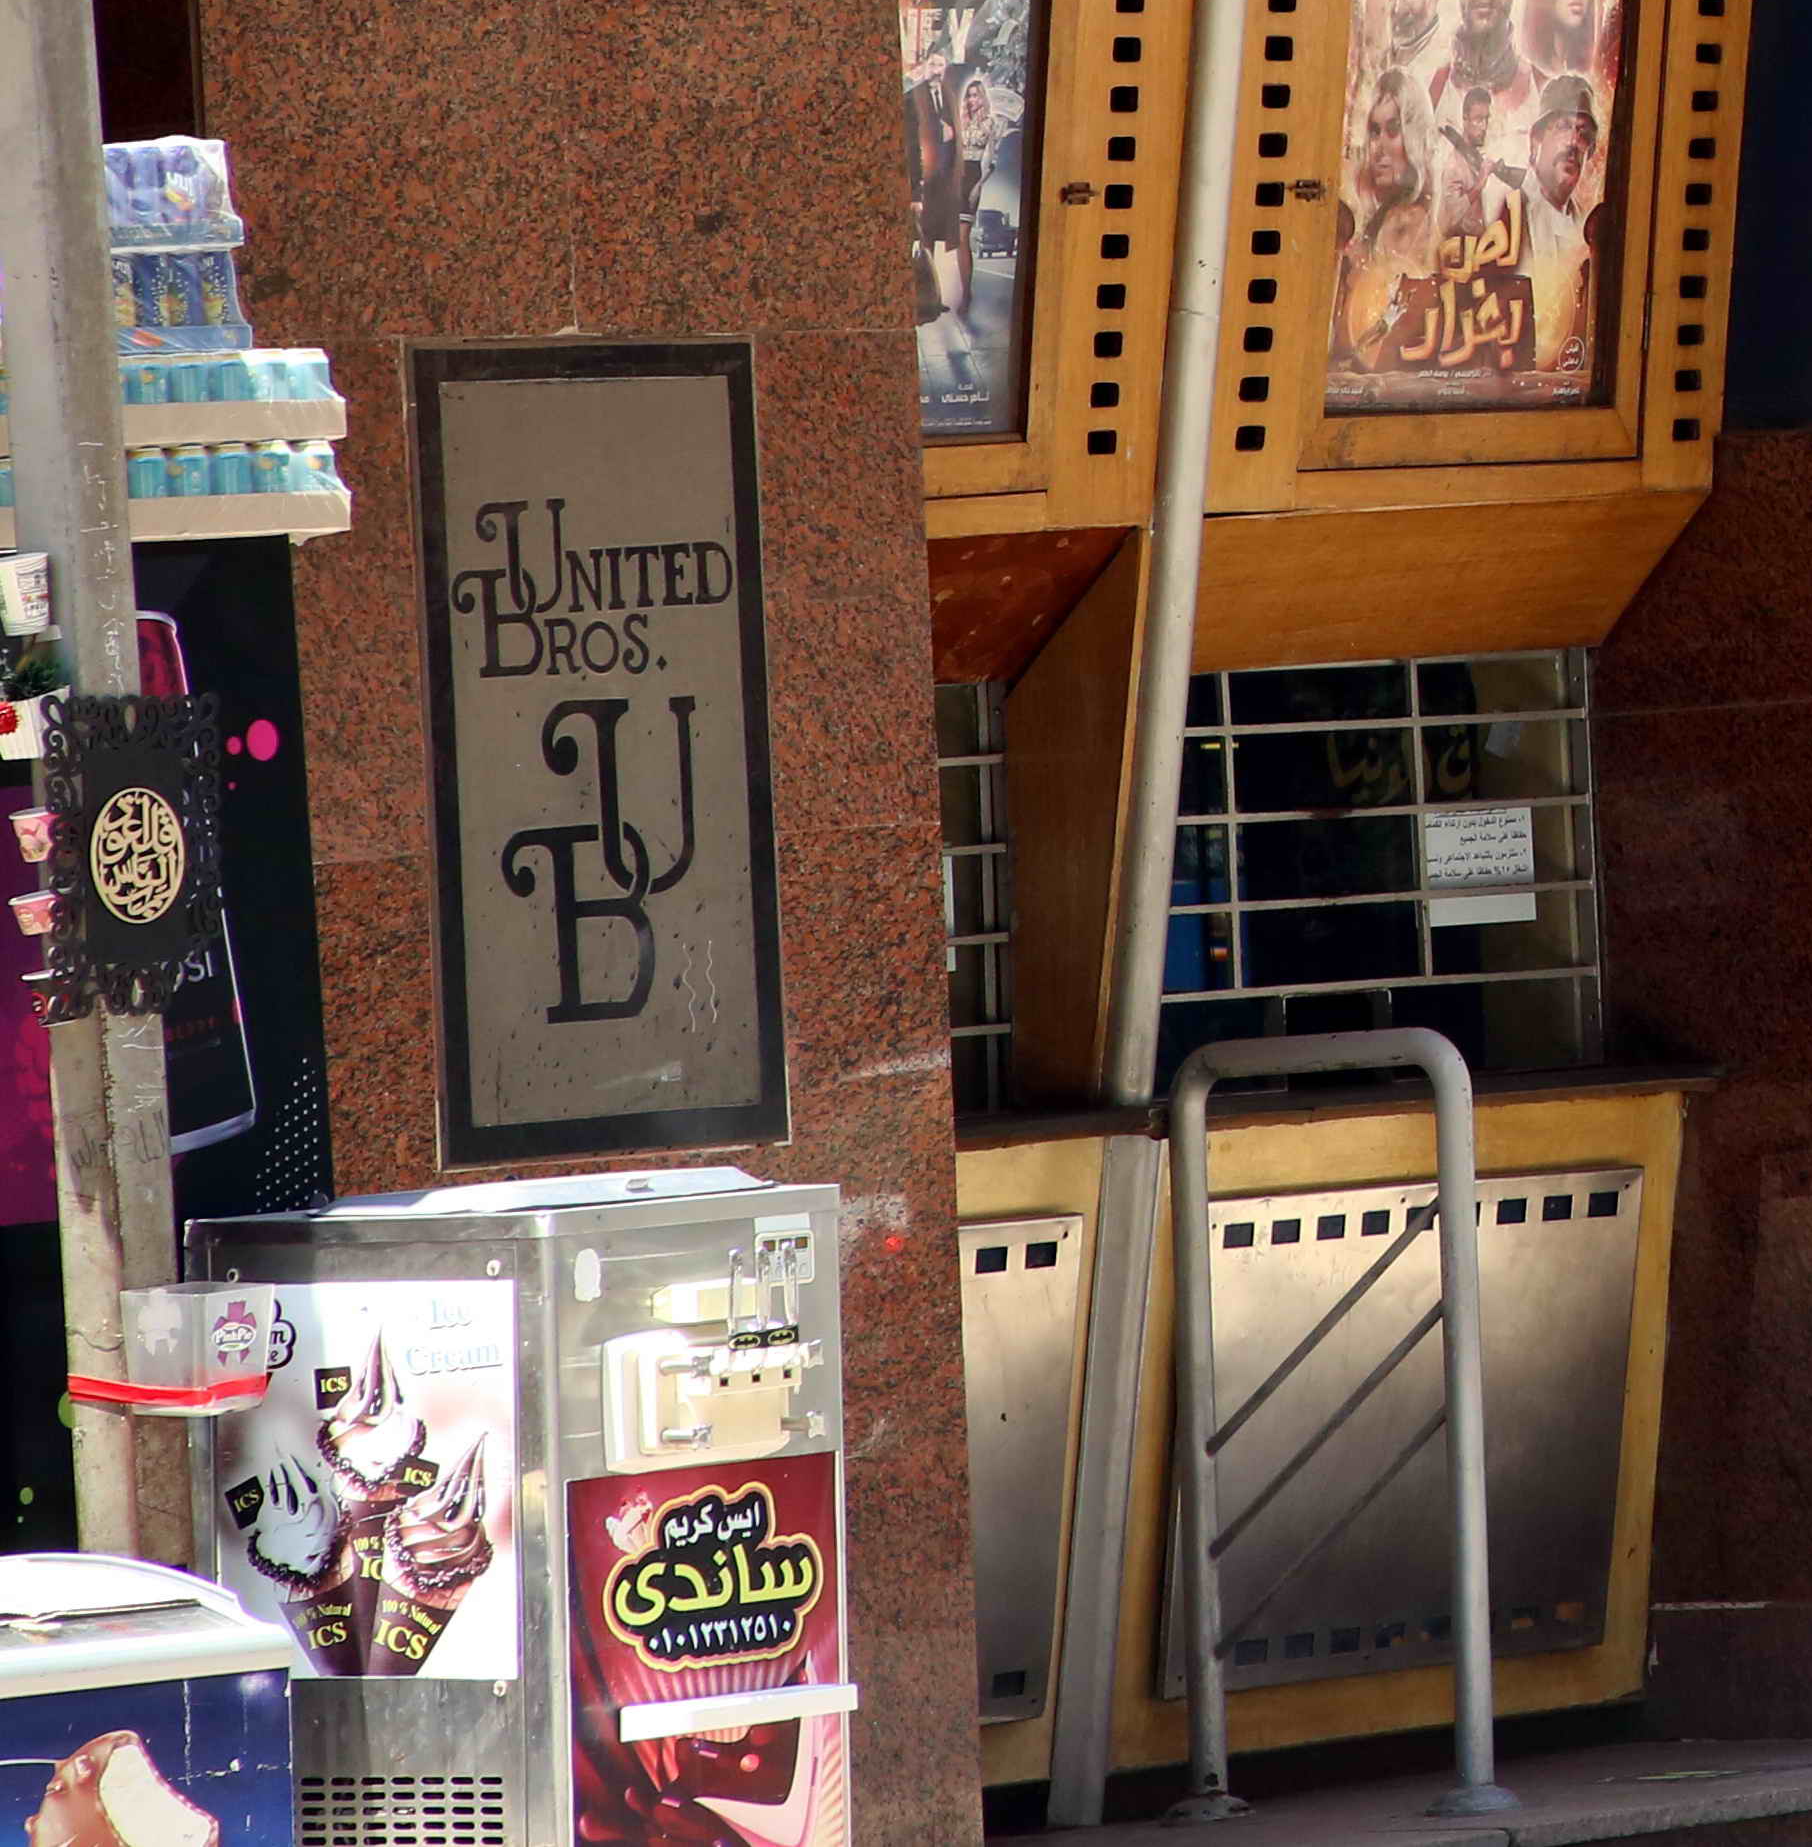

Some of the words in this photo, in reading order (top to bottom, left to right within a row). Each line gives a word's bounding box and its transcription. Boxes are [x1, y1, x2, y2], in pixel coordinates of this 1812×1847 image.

[475, 497, 734, 614] UNITED
[404, 1342, 503, 1377] Cream
[319, 1374, 348, 1394] ICS
[403, 1464, 434, 1489] ICS
[232, 1488, 262, 1513] ICS
[663, 1502, 714, 1549] كريم
[716, 1501, 761, 1542] ايس
[361, 1558, 384, 1581] IC
[306, 1621, 348, 1651] ICS
[373, 1619, 429, 1661] ICS
